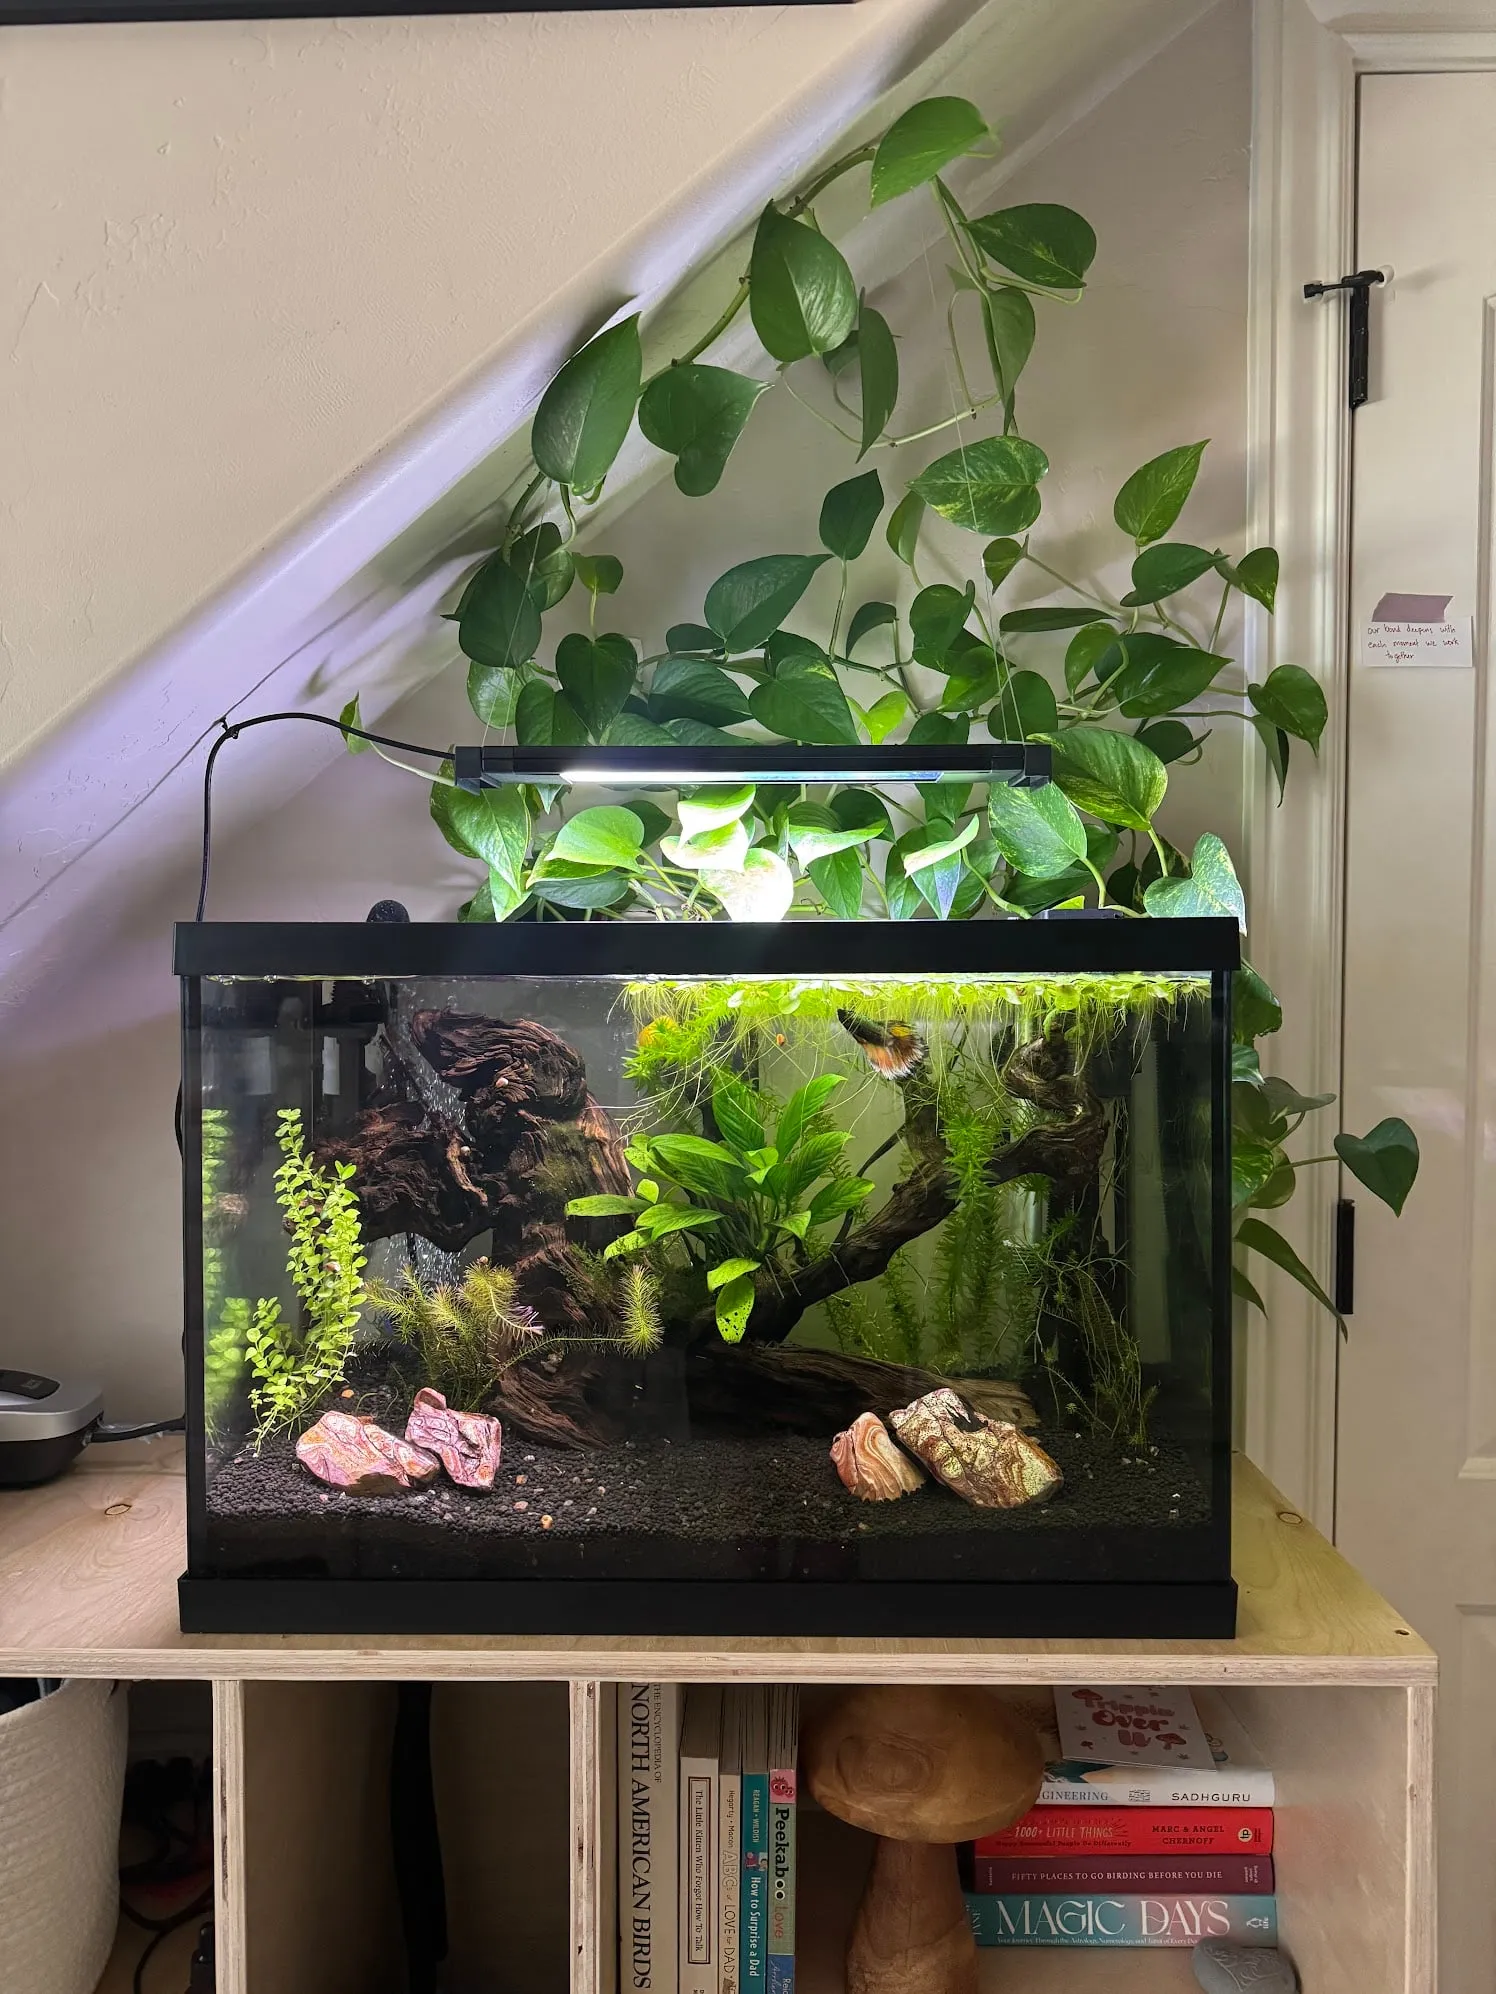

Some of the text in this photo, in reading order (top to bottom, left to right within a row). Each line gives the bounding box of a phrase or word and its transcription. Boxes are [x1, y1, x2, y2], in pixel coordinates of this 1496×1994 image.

[1384, 624, 1401, 633] bond
[1440, 624, 1456, 633] with
[1092, 1709, 1169, 1731] Over
[654, 1684, 662, 1783] THE ENCYCLOPEDIA OF
[727, 1790, 735, 1818] Hegarty
[752, 1789, 760, 1812] REAGAN
[1039, 1791, 1109, 1801] GINEERING
[1171, 1792, 1251, 1802] SADHGURU
[631, 1683, 652, 1989] NORTH AMERICAN BIRDS
[1047, 1827, 1076, 1838] LITTLE
[1080, 1826, 1113, 1839] THINGS
[1162, 1837, 1215, 1845] CHERNOFF
[775, 1807, 790, 1900] Peekaboo
[693, 1790, 703, 1952] The Little Kitten Who Forgot How To Talk
[1040, 1872, 1073, 1880] PLACES
[1075, 1872, 1088, 1880] TO
[1090, 1872, 1104, 1880] GO
[1148, 1871, 1183, 1879] BEFORE
[1185, 1871, 1203, 1879] YOU
[1206, 1871, 1223, 1879] DIE
[750, 1876, 762, 1896] How
[750, 1899, 759, 1909] to
[724, 1904, 736, 1934] LOVE
[747, 1911, 760, 1948] Surprise
[774, 1905, 789, 1939] Love
[996, 1900, 1230, 1936] MAGIC DAYS
[723, 1947, 736, 1973] DAD
[749, 1959, 760, 1977] Dad
